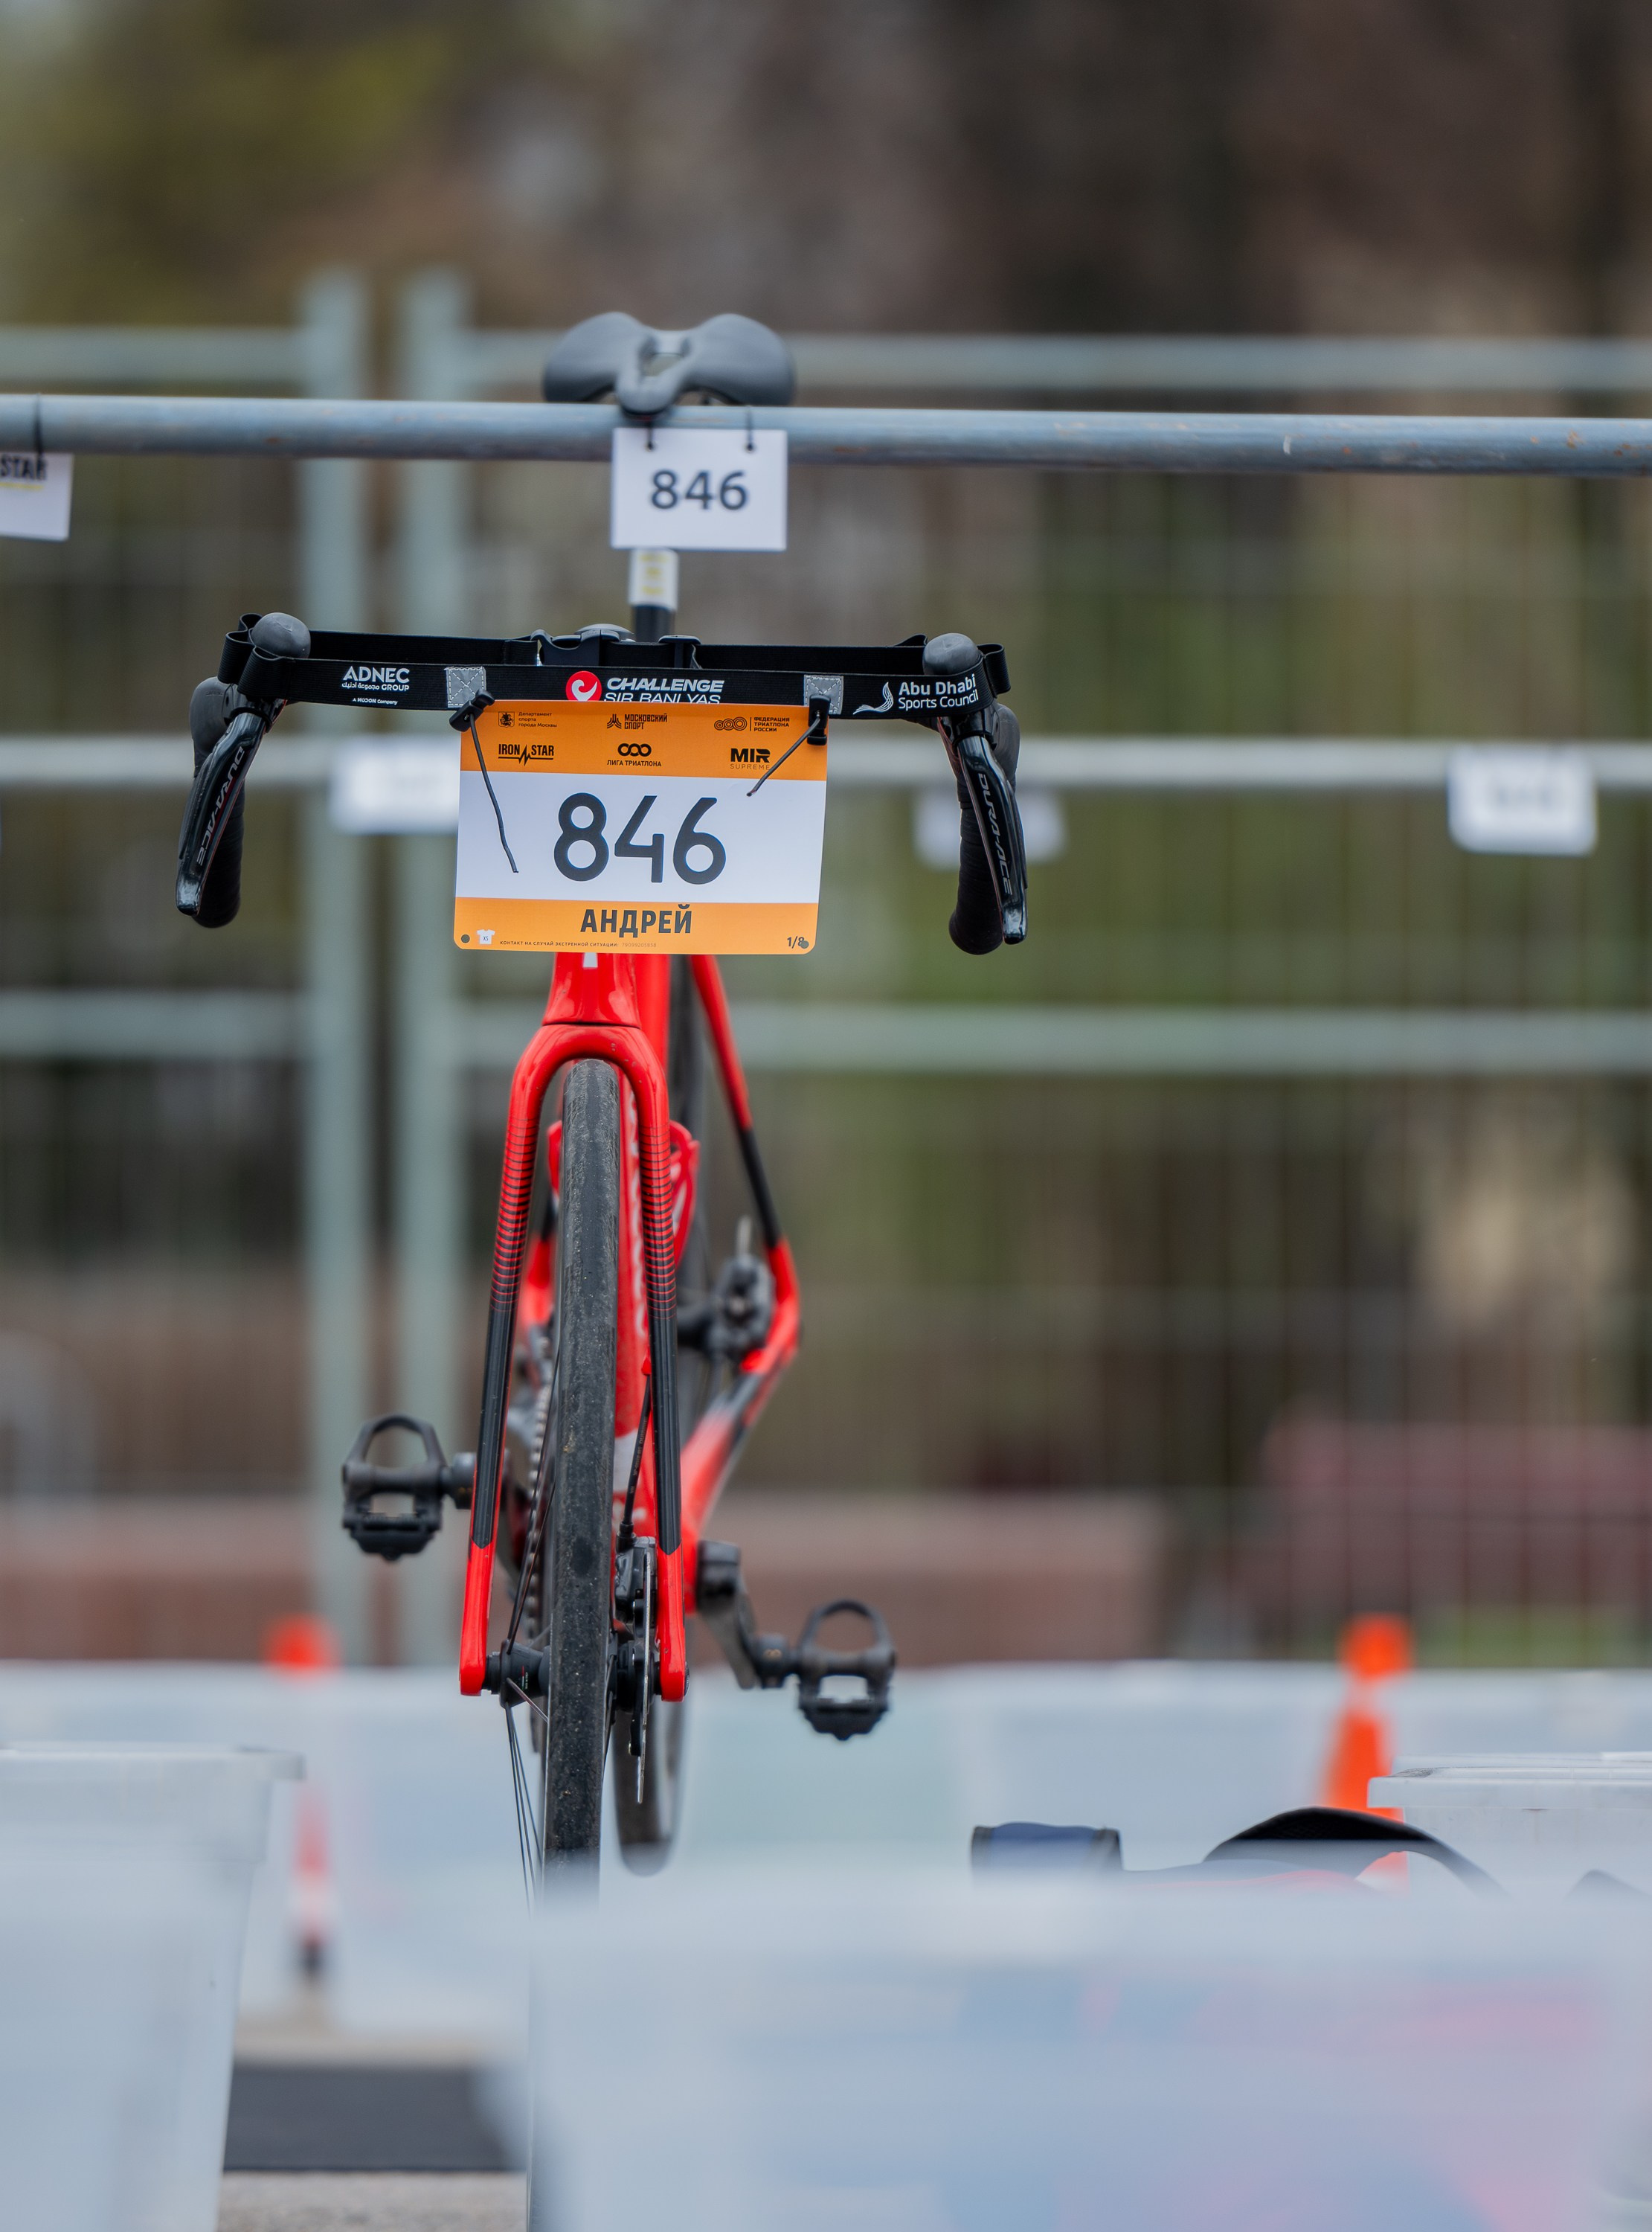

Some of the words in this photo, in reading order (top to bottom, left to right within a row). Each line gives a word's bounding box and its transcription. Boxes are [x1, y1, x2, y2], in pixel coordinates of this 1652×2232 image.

[650, 469, 748, 510] 846
[342, 665, 410, 684] ADNEC
[381, 684, 410, 692] GROUP
[606, 677, 724, 693] CHALLENGE
[899, 682, 931, 696] Abu
[935, 673, 976, 696] Dhabi
[898, 696, 937, 711] Sports
[939, 689, 979, 708] Council
[624, 713, 668, 722] МОСКОВСКИЙ
[624, 722, 645, 730] СПОРТ
[498, 744, 521, 755] IRON
[530, 745, 555, 756] STAR
[730, 748, 771, 763] MIR
[196, 745, 245, 867] DURA-ACE
[553, 792, 727, 885] 846
[977, 772, 1013, 896] DURA-ACE
[580, 903, 692, 938] АНДРЕЙ
[787, 935, 805, 949] 1/8
